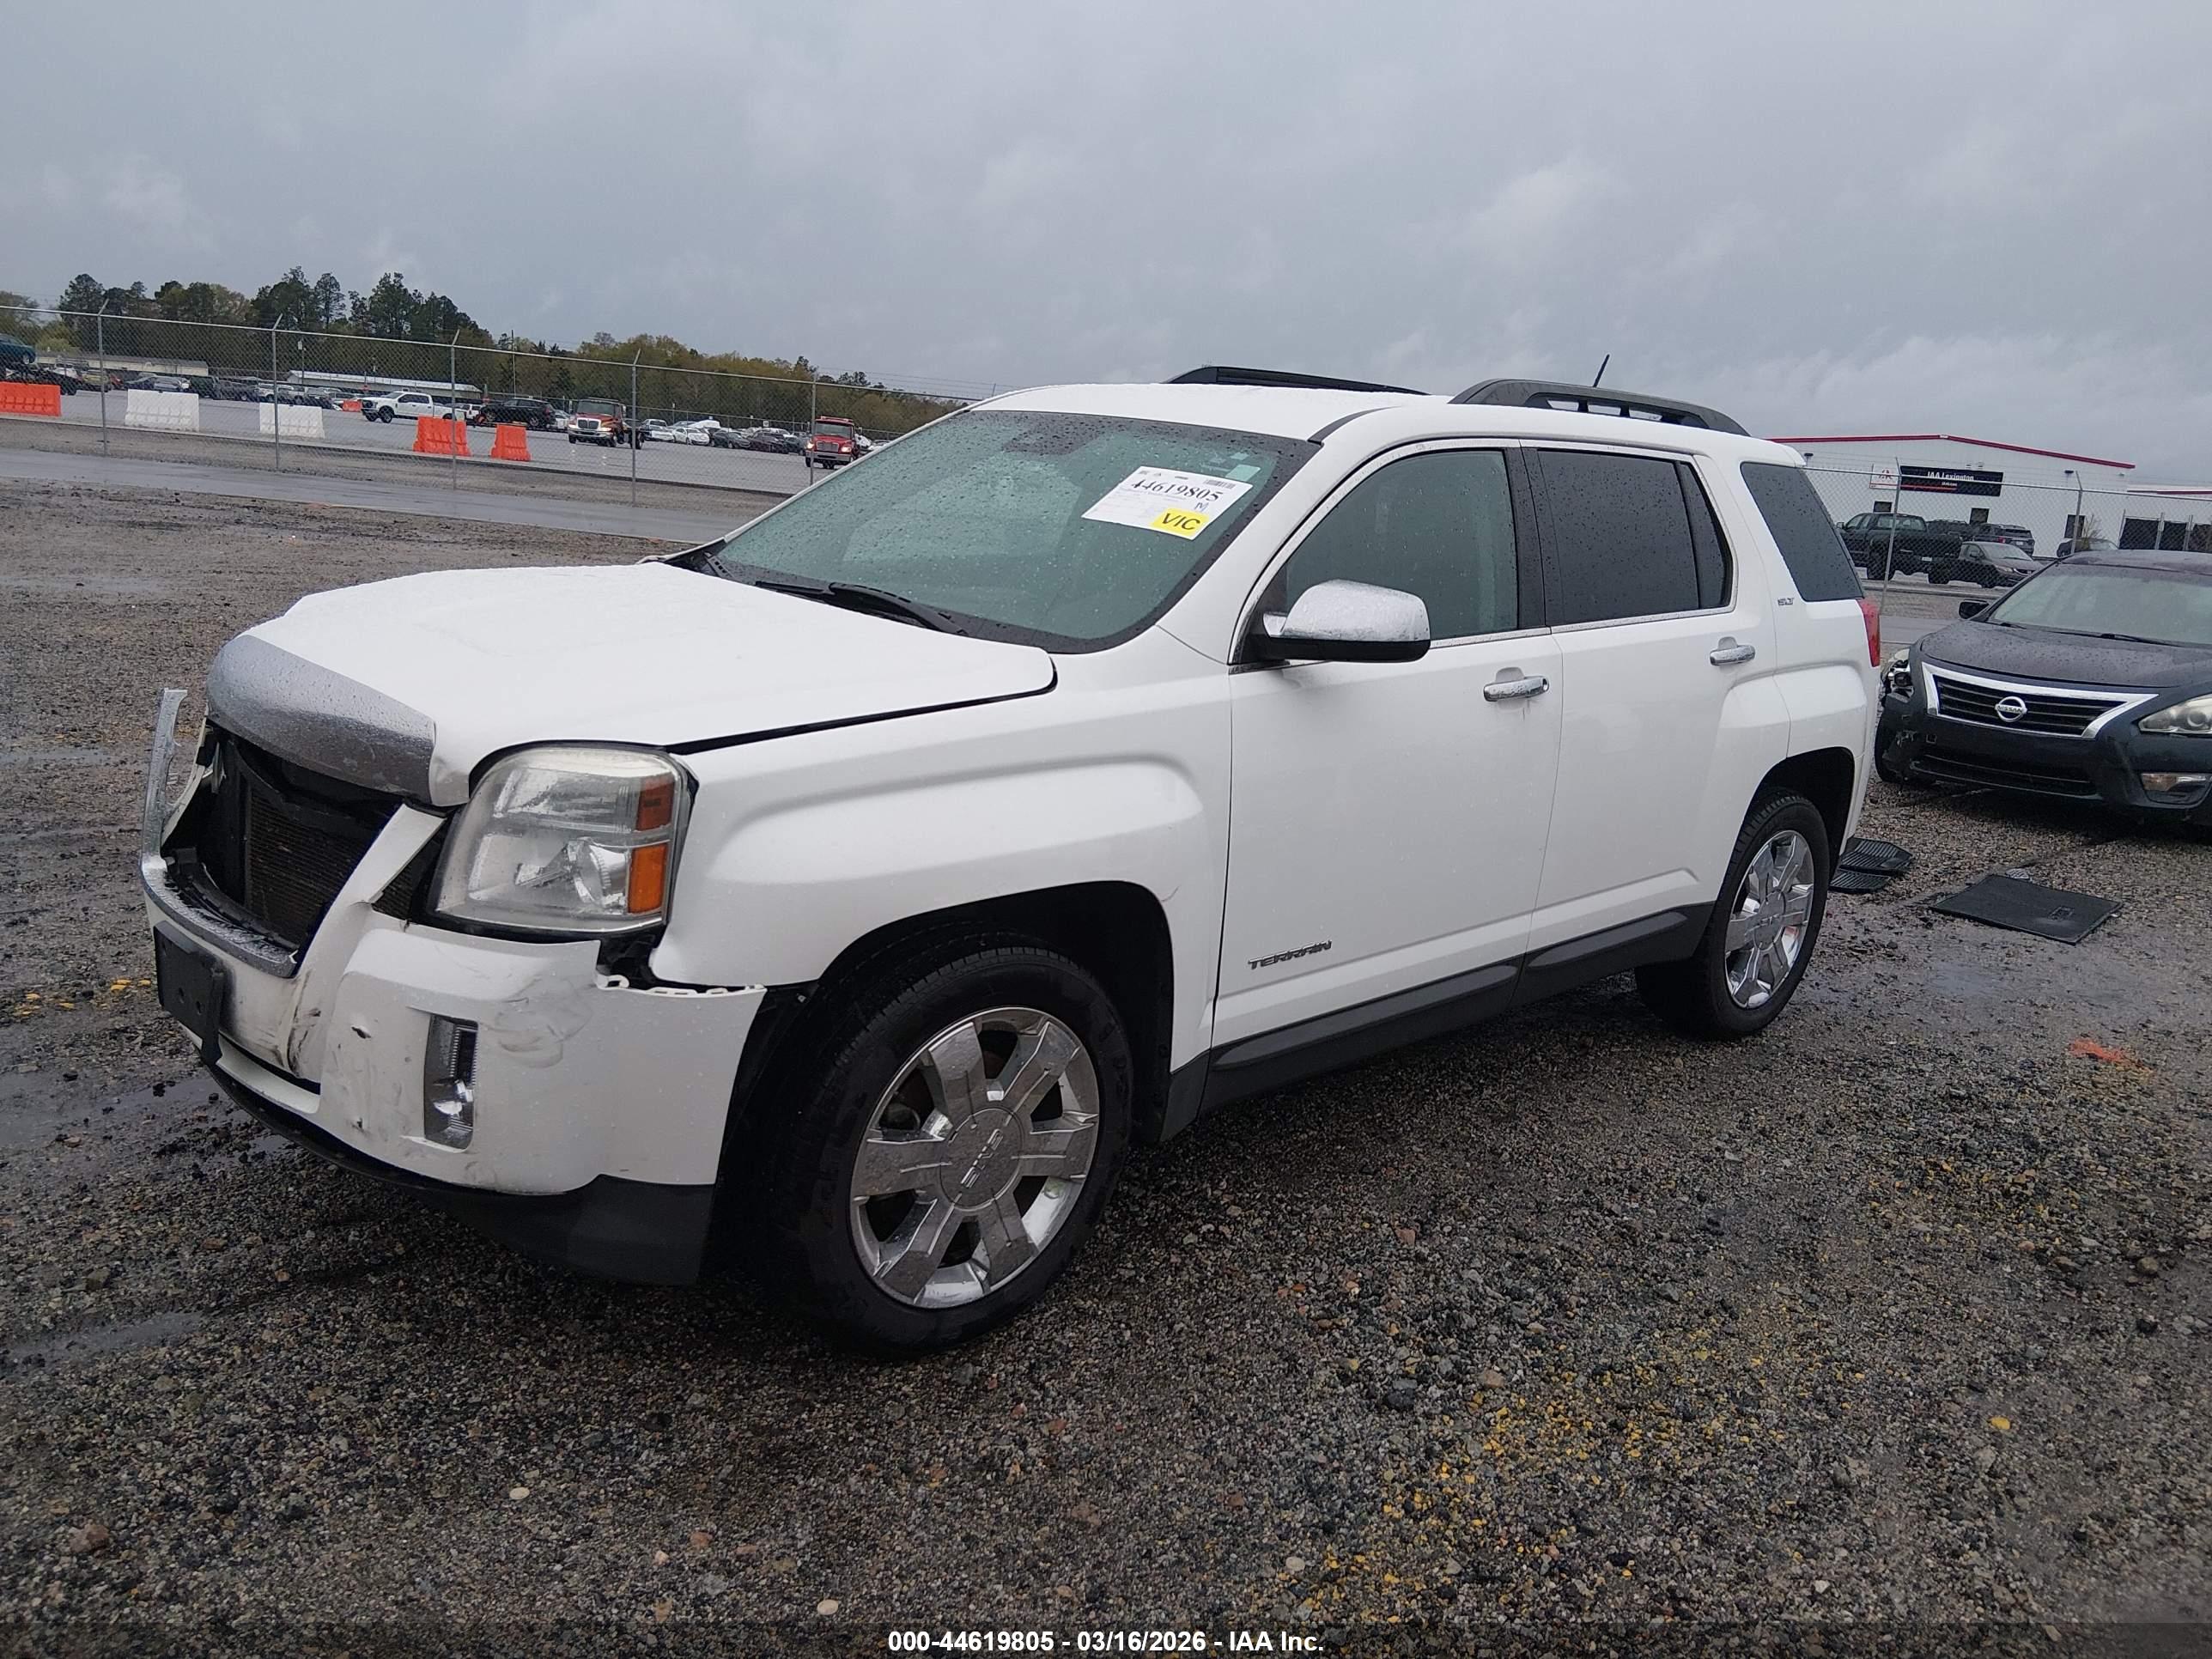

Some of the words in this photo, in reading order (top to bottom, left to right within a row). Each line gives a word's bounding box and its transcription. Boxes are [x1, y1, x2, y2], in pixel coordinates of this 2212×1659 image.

[1927, 471, 1941, 479] IAA
[1942, 471, 1974, 481] Lexington
[1130, 477, 1224, 503] 44619805
[1162, 512, 1201, 531] VIC
[1778, 597, 1795, 606] SLT
[1996, 704, 2023, 714] NISSAN
[1248, 939, 1333, 970] TERRAIN
